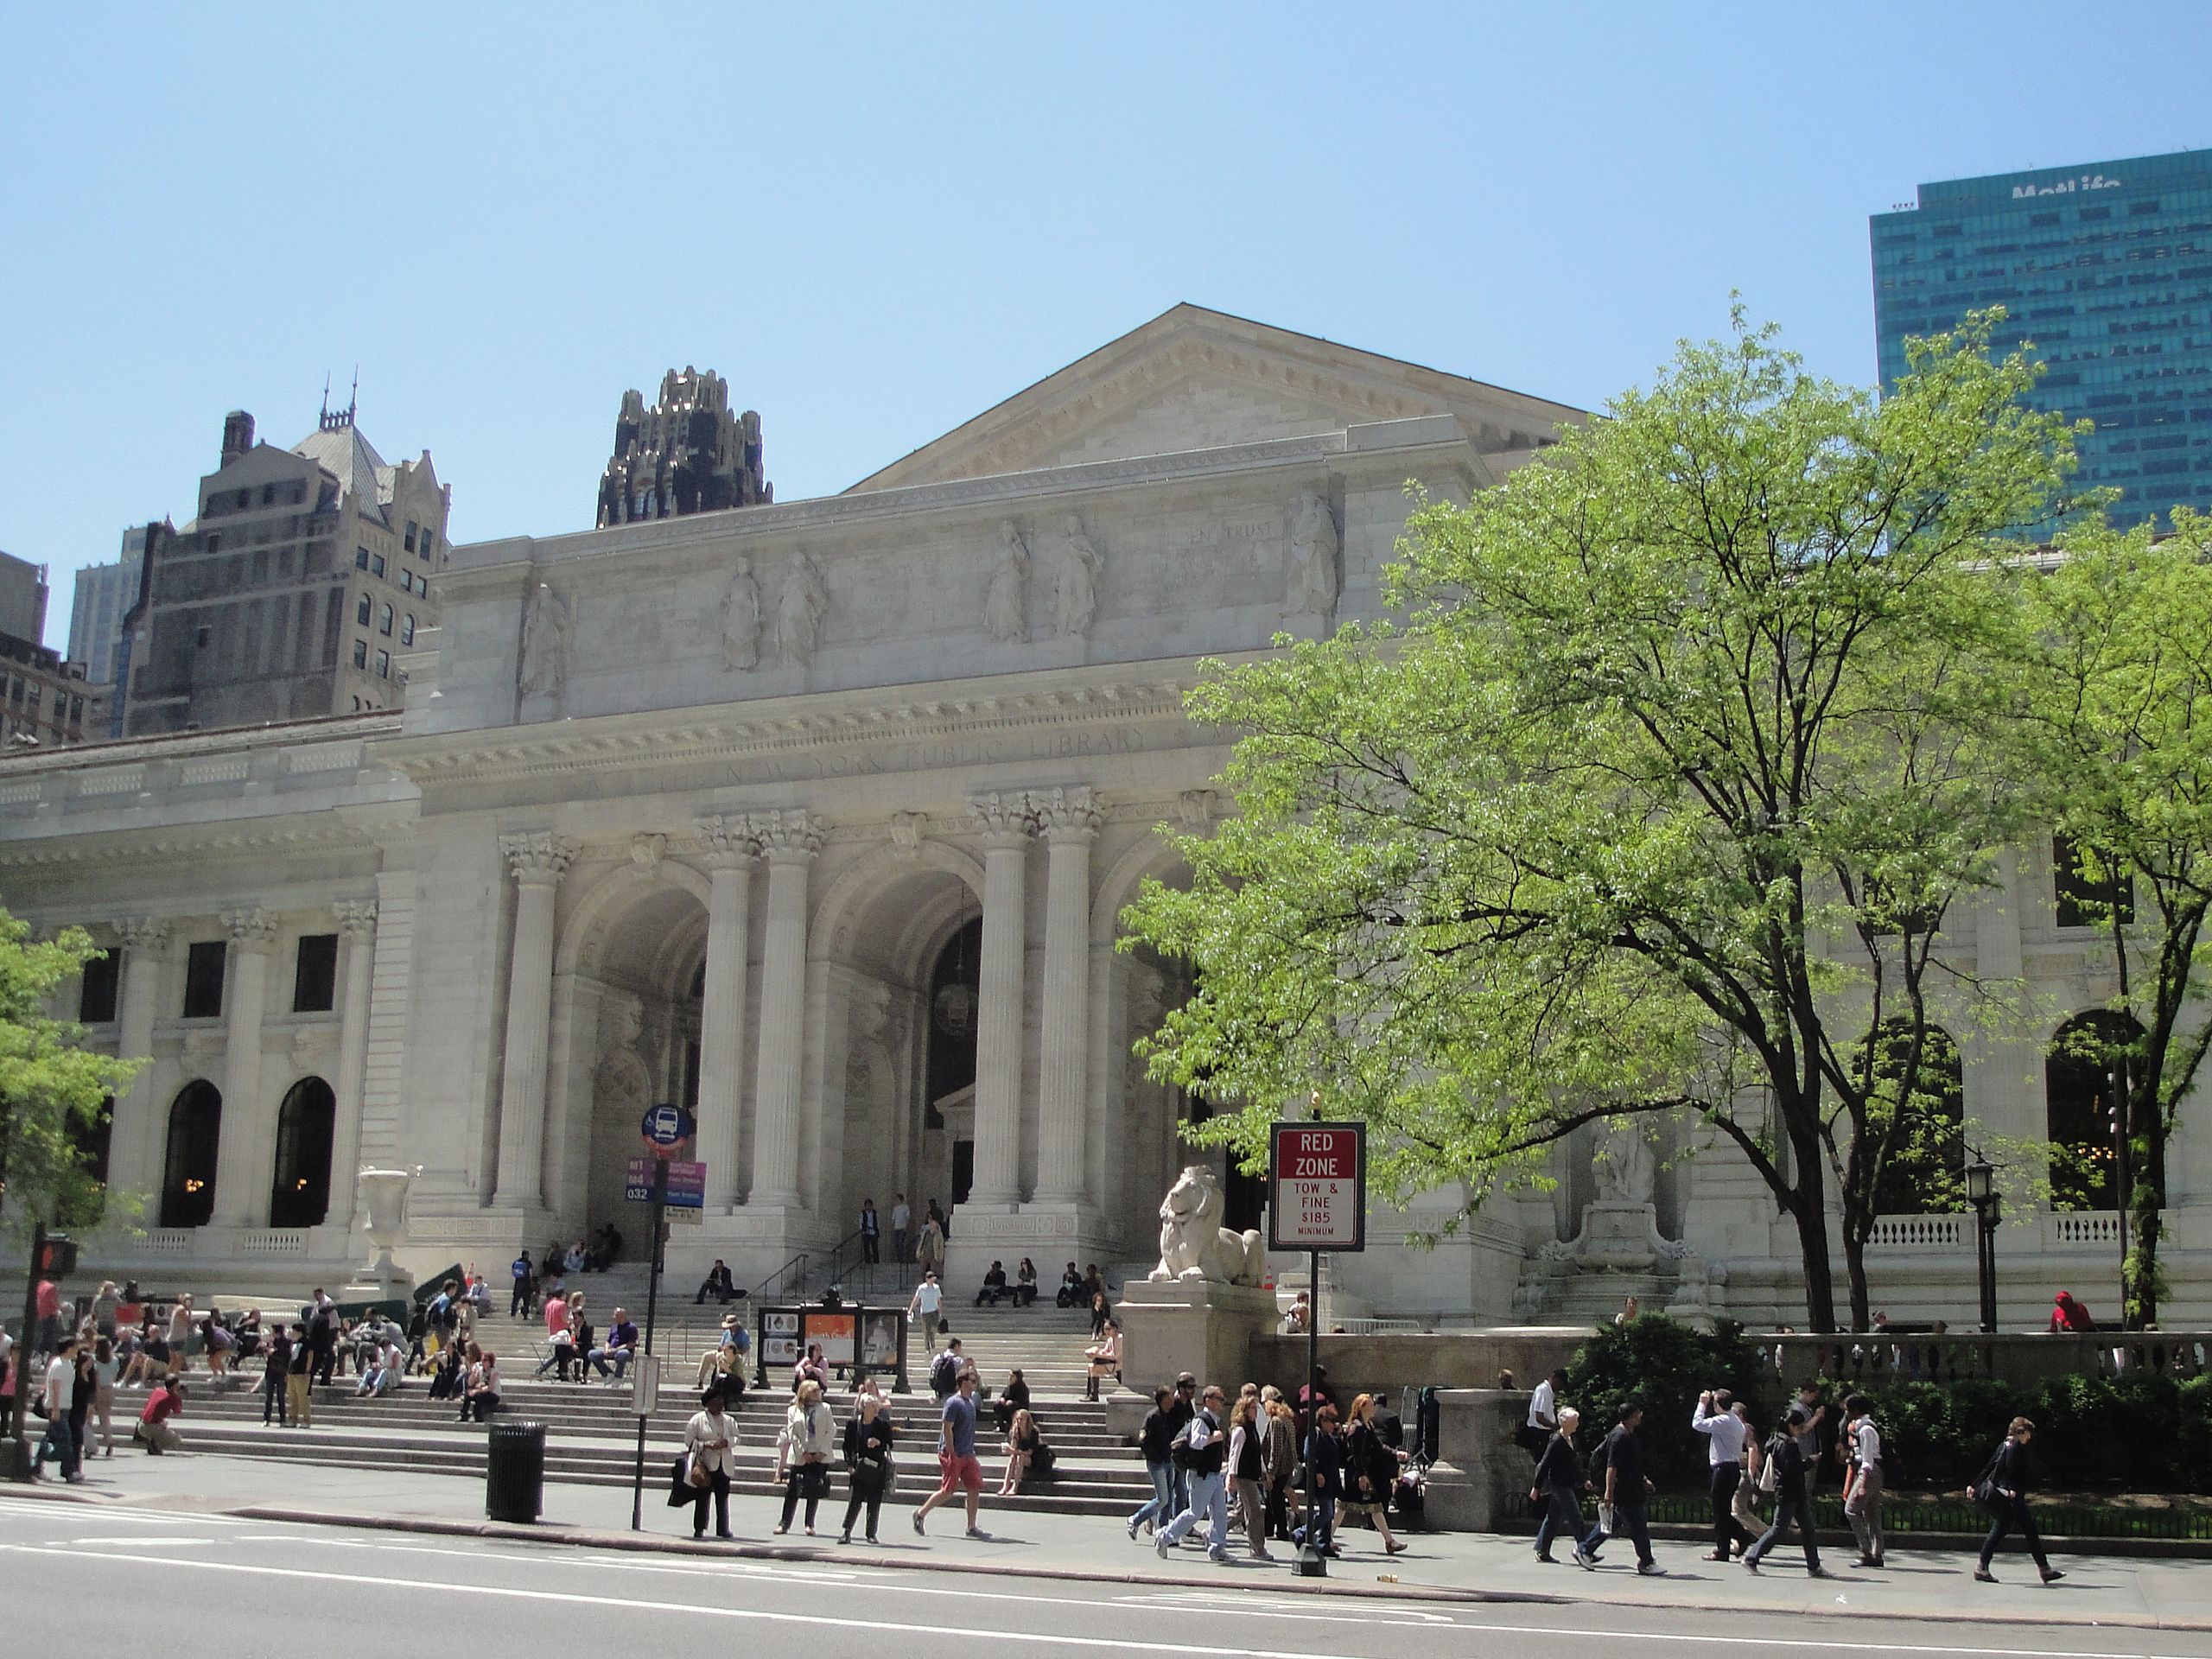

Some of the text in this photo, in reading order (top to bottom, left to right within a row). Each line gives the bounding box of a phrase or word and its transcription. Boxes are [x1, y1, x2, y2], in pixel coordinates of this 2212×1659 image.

[814, 753, 887, 778] YORK
[906, 740, 1002, 770] PUBLIC
[1031, 728, 1145, 754] LIBRARY
[1300, 1133, 1333, 1152] RED
[1295, 1158, 1338, 1176] ZONE
[1294, 1182, 1338, 1194] TOW &
[1301, 1197, 1331, 1208] FINE
[1301, 1211, 1331, 1224] $185
[1298, 1227, 1334, 1236] MINIMUM
